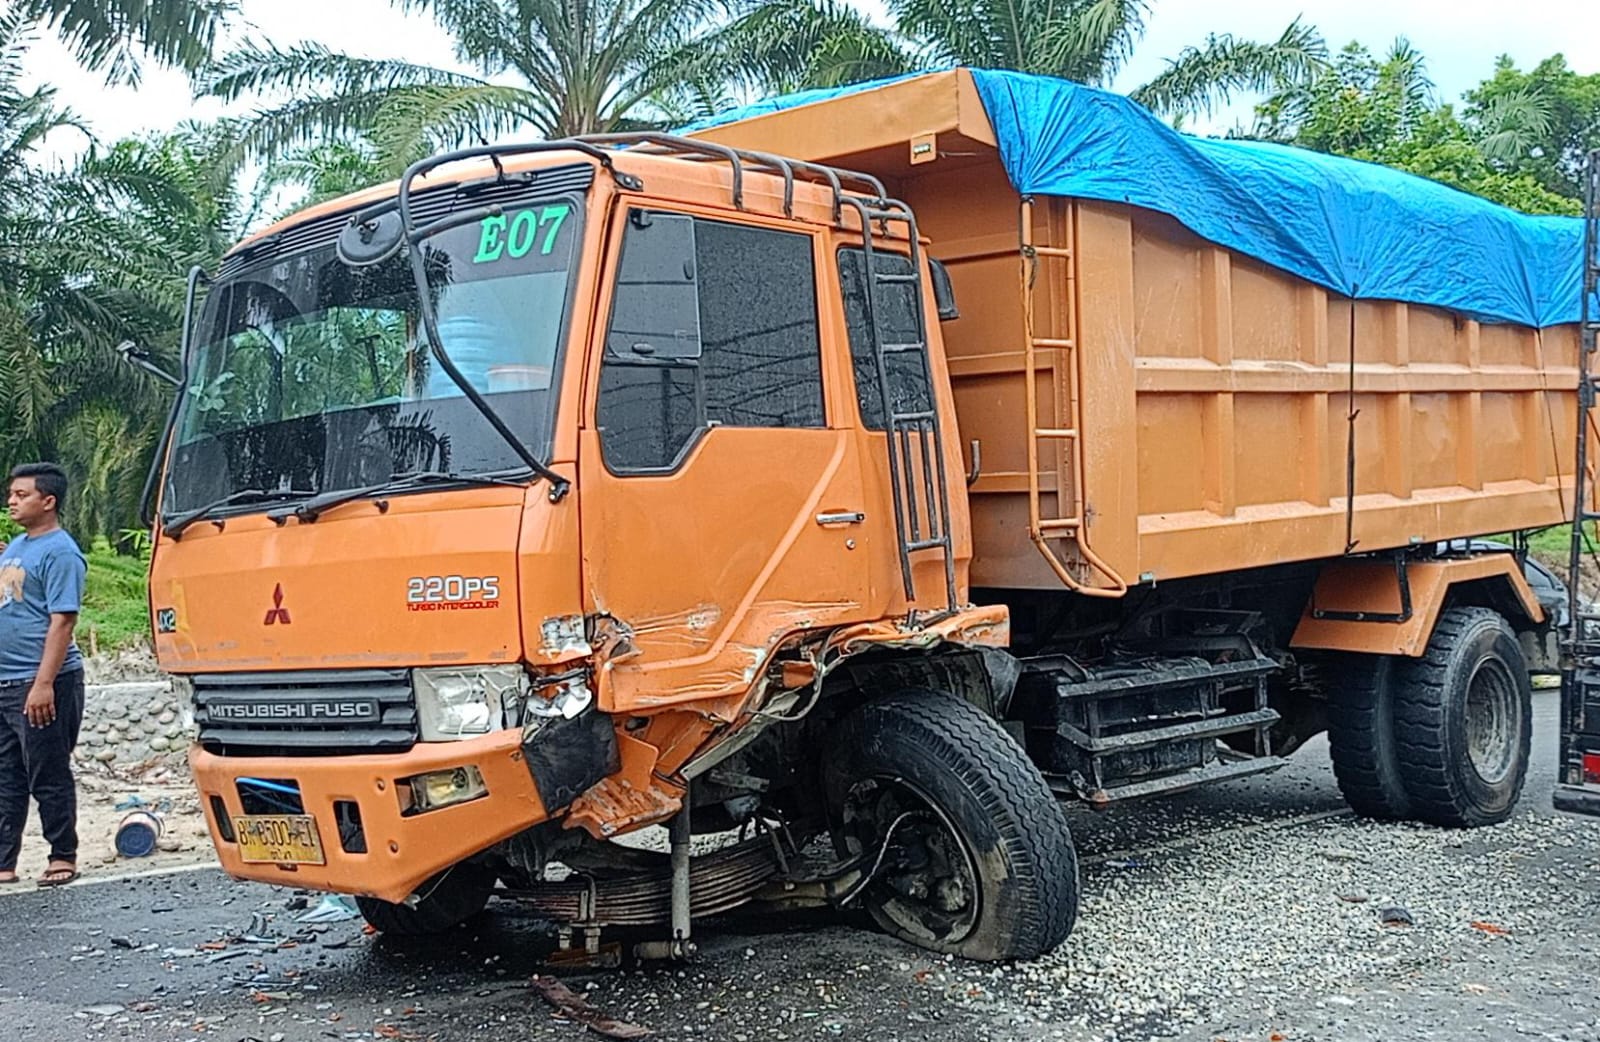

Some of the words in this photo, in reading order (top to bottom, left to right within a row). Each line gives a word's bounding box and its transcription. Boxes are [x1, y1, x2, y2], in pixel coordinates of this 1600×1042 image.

[473, 205, 569, 263] E07
[407, 575, 500, 602] 220PS
[407, 603, 436, 612] TURBO
[437, 601, 499, 611] INTERCOOLER
[208, 704, 305, 717] MITSUBISHI
[312, 703, 372, 716] FUSO
